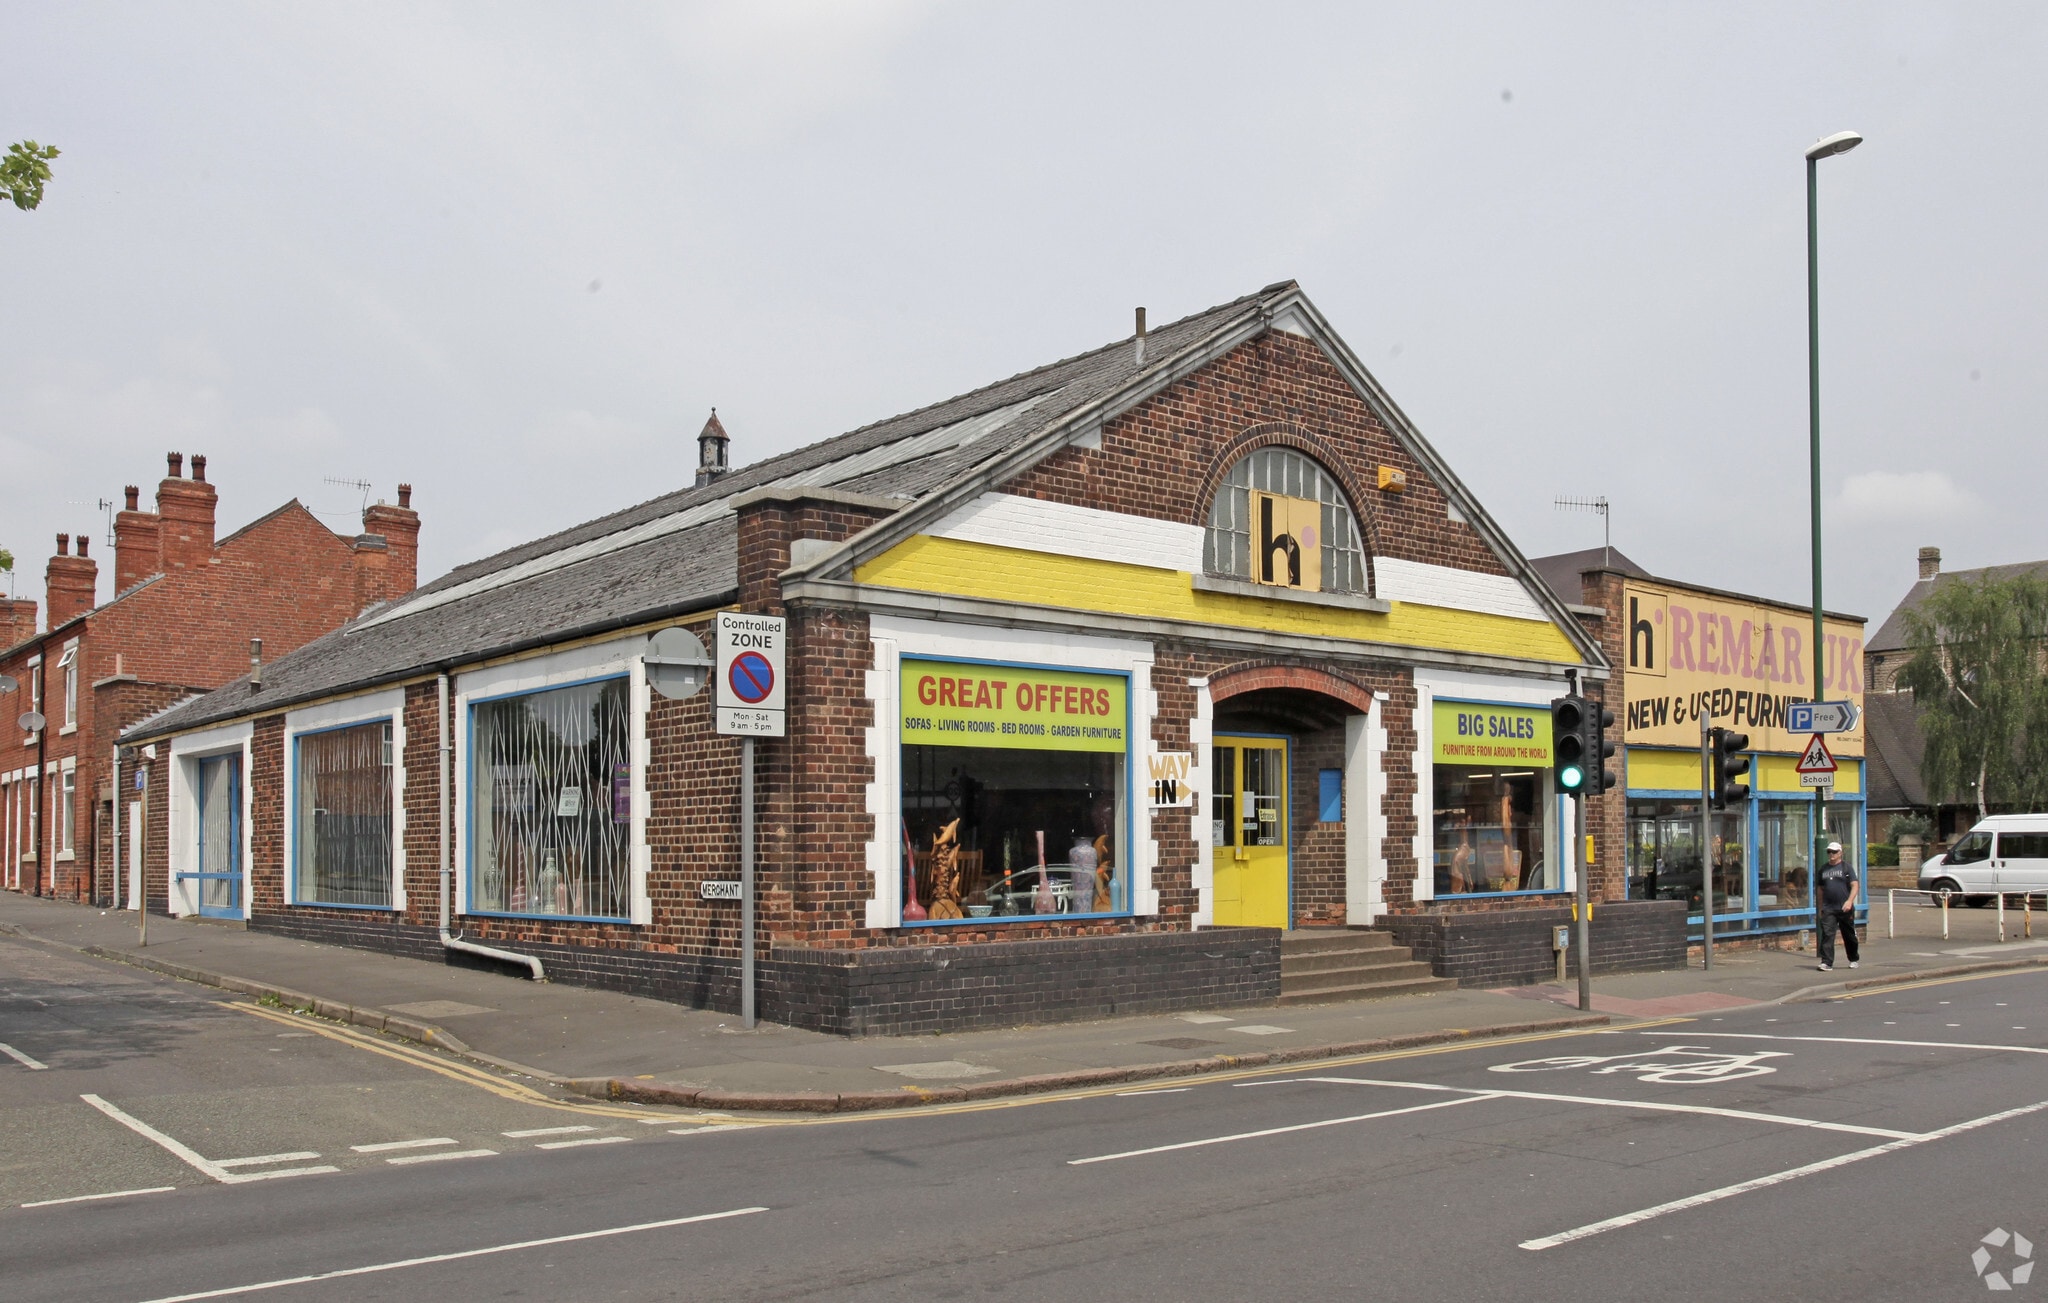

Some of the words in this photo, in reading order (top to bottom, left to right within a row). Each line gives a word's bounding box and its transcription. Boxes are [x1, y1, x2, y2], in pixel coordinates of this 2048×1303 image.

[722, 617, 781, 633] Controlled
[731, 633, 772, 649] ZONE
[1669, 605, 1805, 686] REMAR
[1822, 633, 1862, 694] UK
[918, 675, 1007, 710] GREAT
[1015, 682, 1111, 717] OFFERS
[733, 712, 750, 721] Mon
[755, 713, 769, 721] Sat
[1627, 696, 1670, 731] NEW
[1673, 696, 1687, 725] &
[1690, 687, 1733, 722] USED
[730, 721, 736, 729] 9
[754, 722, 759, 730] 5
[760, 724, 772, 732] pm
[1458, 713, 1484, 737] BIG
[1489, 715, 1534, 739] SALES
[1796, 710, 1810, 728] P
[1814, 713, 1834, 721] Free
[905, 717, 932, 730] SOFAS
[938, 719, 965, 732] LIVING
[967, 721, 995, 733] ROOMS
[1002, 722, 1017, 735] BED
[1019, 723, 1045, 736] ROOMS
[1051, 725, 1081, 737] GARDEN
[1082, 726, 1122, 740] FURNITURE
[1443, 744, 1475, 757] FURNITURE
[1476, 745, 1493, 757] FROM
[1494, 746, 1517, 758] AROUND
[1517, 747, 1528, 759] THE
[1529, 748, 1547, 759] WORLD
[1147, 754, 1190, 780] WAY
[1258, 838, 1275, 846] OPEN
[702, 883, 739, 897] MERCHANT
